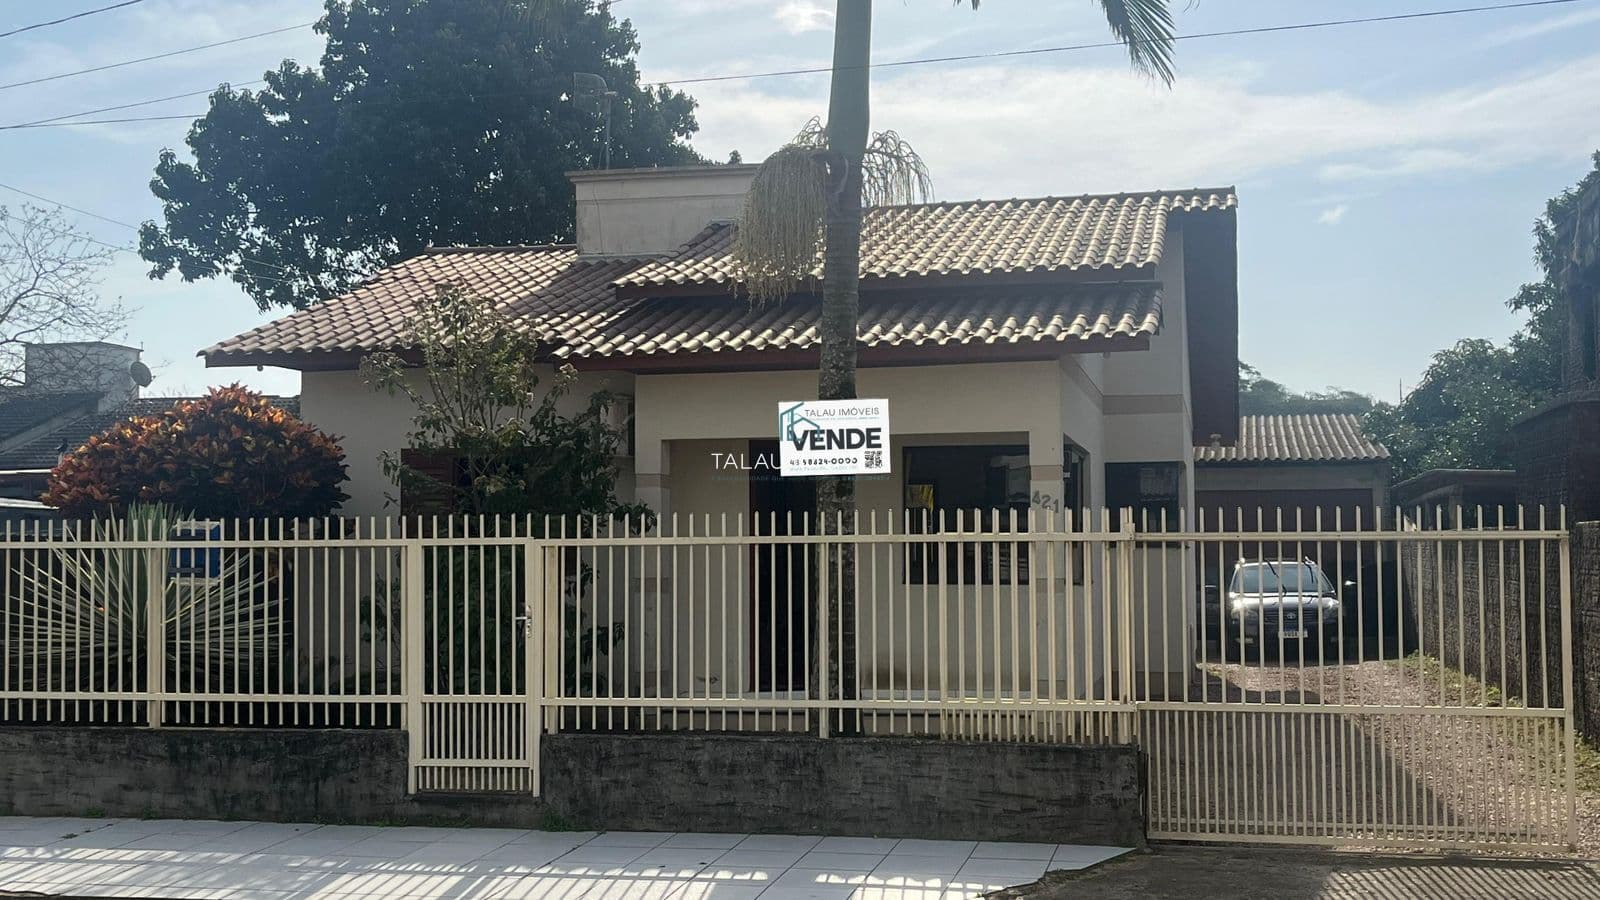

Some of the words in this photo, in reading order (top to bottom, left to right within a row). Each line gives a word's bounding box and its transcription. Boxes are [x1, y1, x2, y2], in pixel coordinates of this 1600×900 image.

[805, 409, 836, 417] TALAU
[838, 406, 880, 416] IMÓVEIS
[788, 427, 882, 451] VENDE
[1032, 490, 1059, 513] 421
